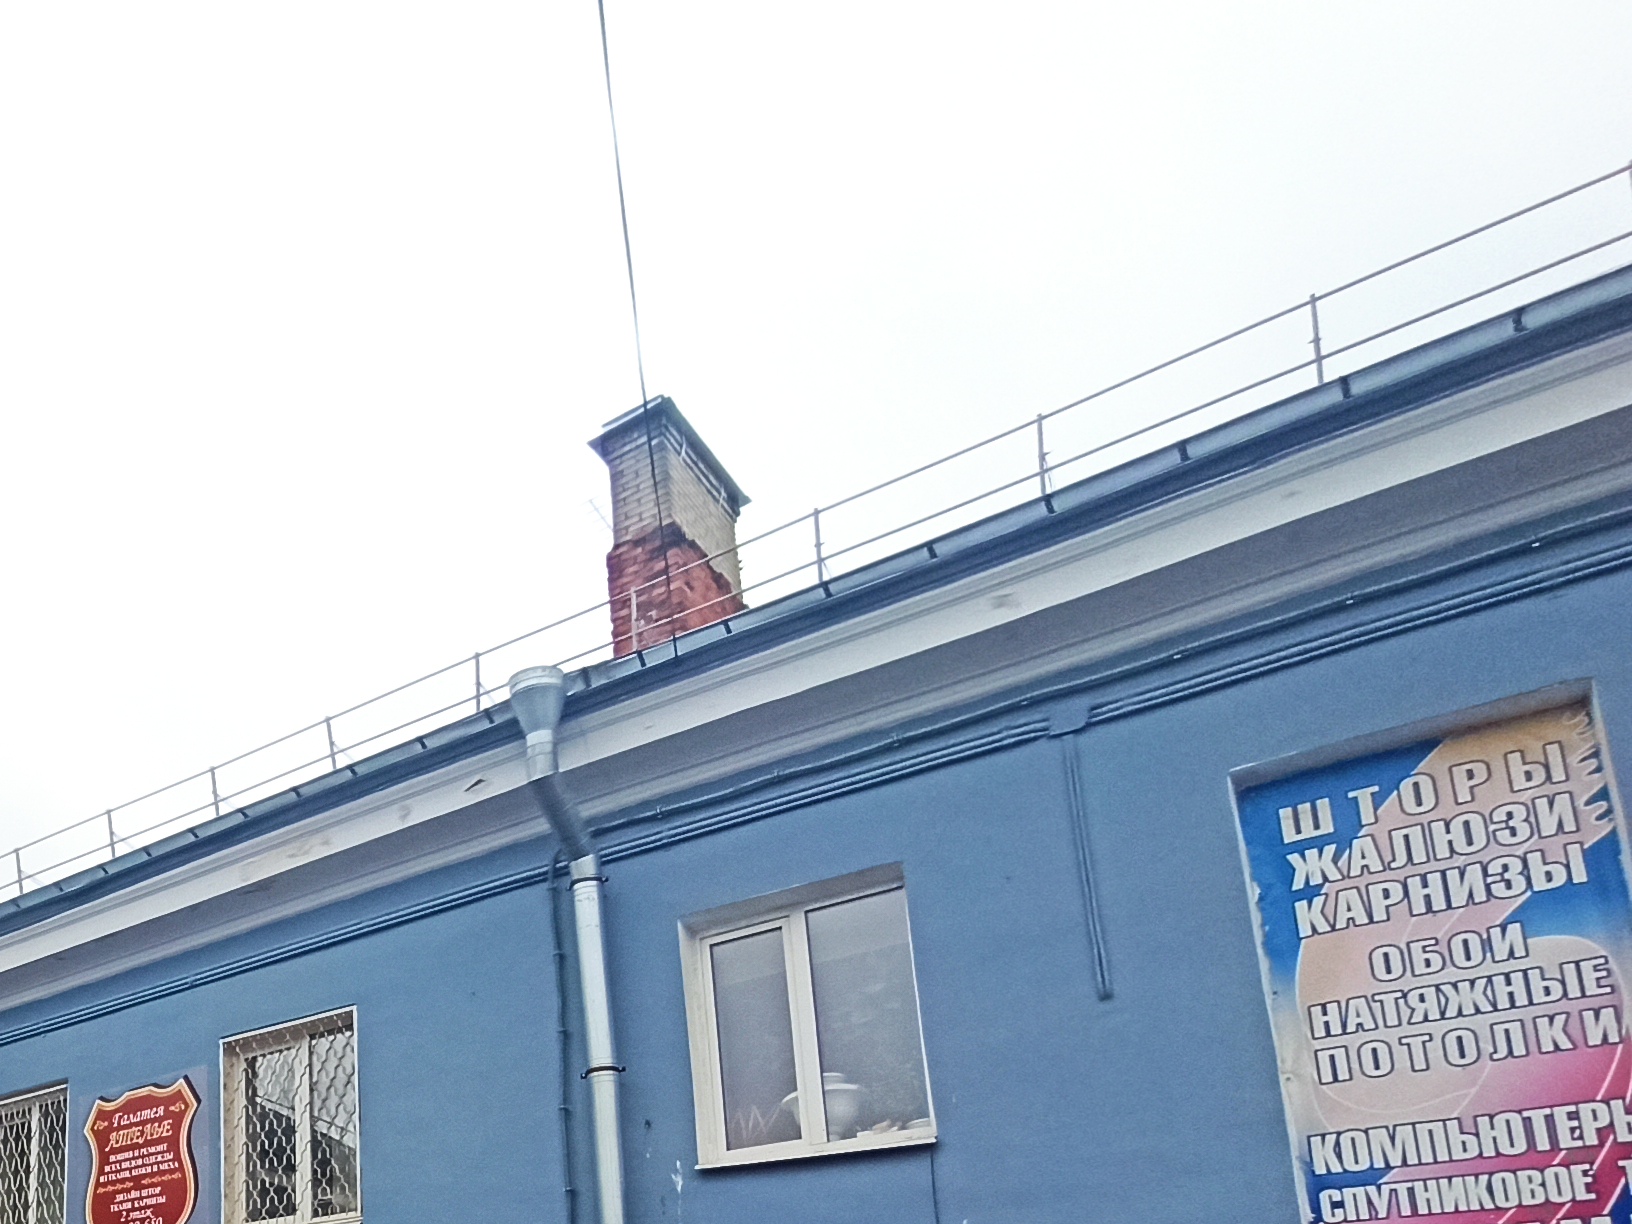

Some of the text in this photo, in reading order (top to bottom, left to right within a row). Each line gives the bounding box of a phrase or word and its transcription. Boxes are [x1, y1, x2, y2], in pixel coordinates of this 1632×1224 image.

[1279, 742, 1568, 843] ШТОРЫ
[1286, 793, 1579, 892] ЖАЛЮЗИ
[1294, 841, 1588, 939] КАРНИЗЫ
[1368, 922, 1529, 983] ОБОИ
[1309, 955, 1613, 1040] НАТЯЖНЫЕ
[1315, 1006, 1622, 1086] ПОТОЛКИ
[105, 1119, 172, 1152] АТЕЛЬЕ
[112, 1106, 164, 1127] Галатея
[120, 1211, 127, 1222] 2
[1319, 1163, 1597, 1224] СПУТНИКОВОЕ
